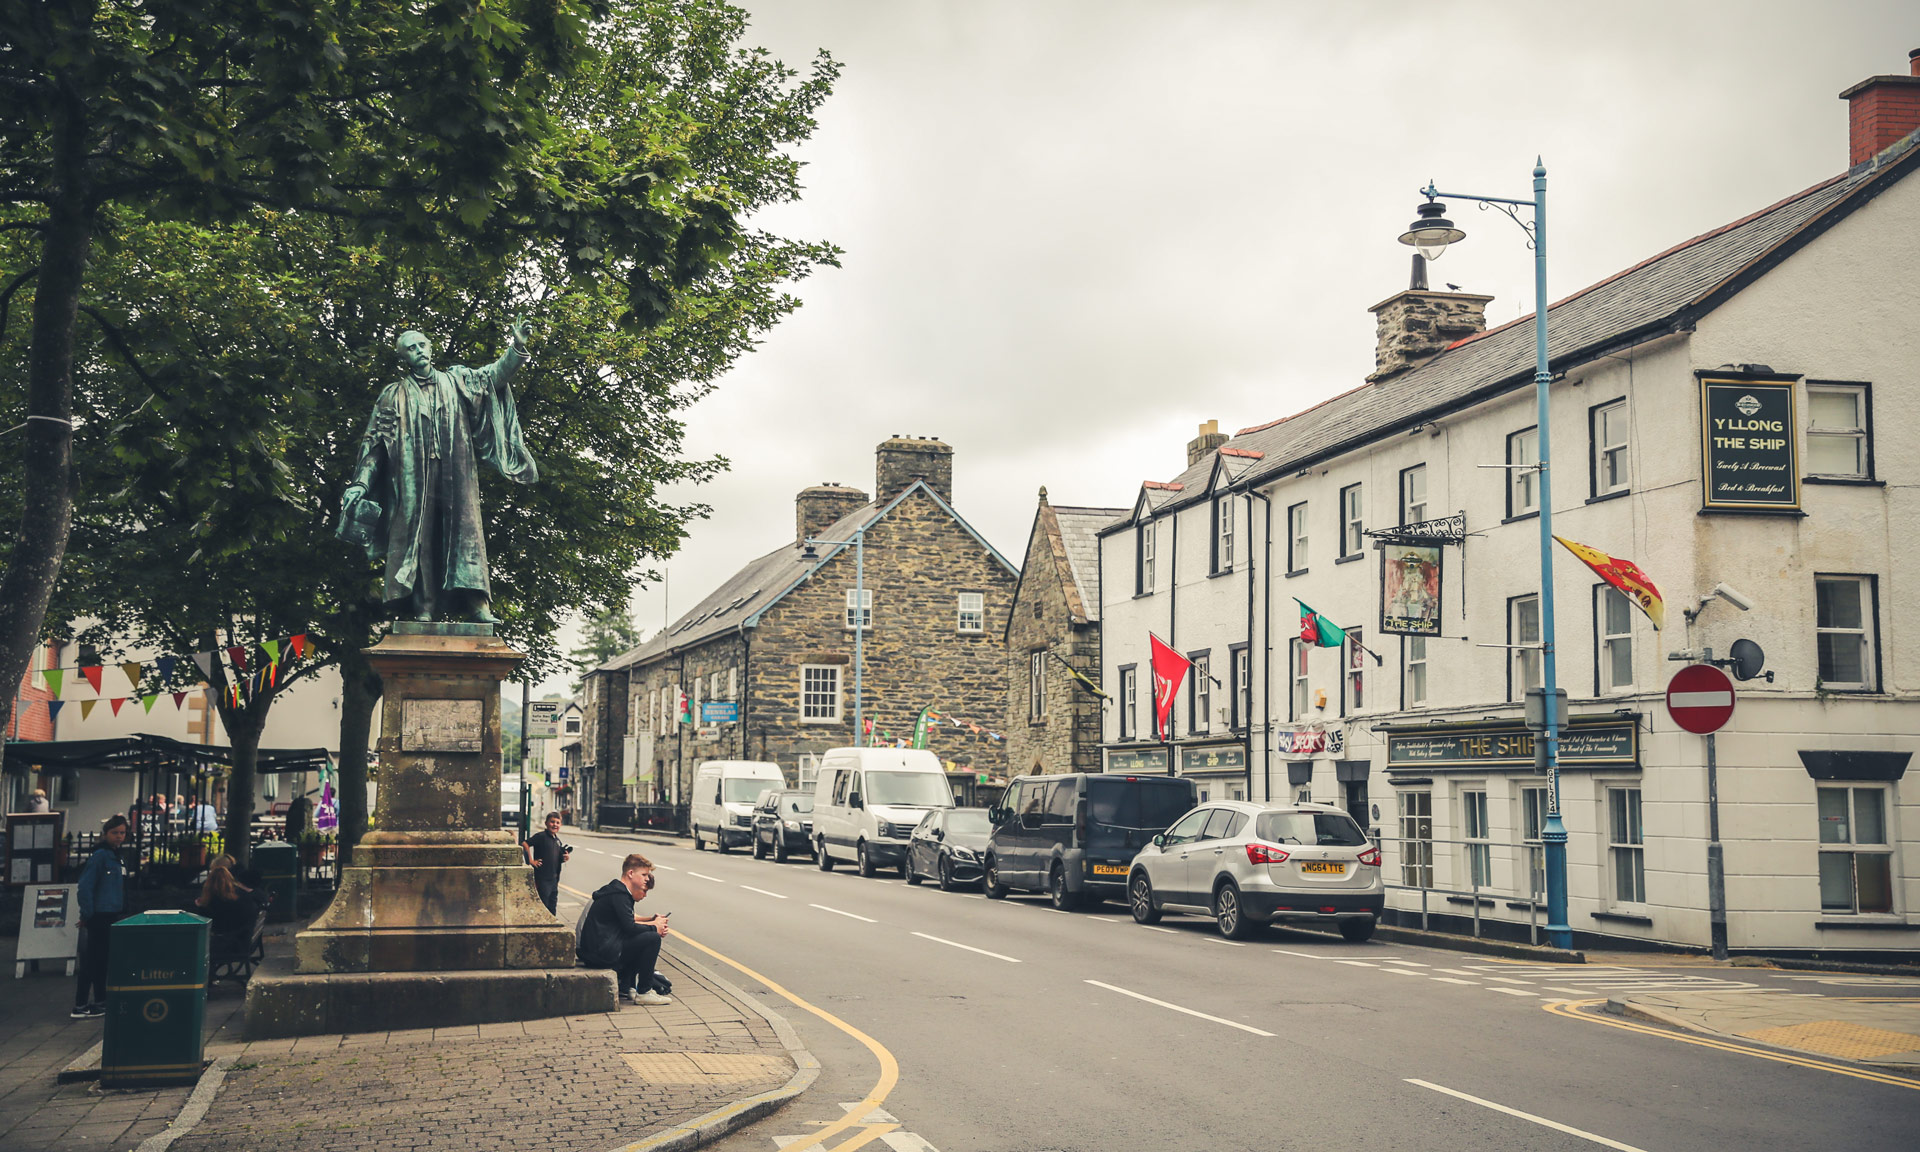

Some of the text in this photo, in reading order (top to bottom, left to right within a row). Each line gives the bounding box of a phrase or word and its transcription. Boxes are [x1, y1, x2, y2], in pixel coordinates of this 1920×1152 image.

[1714, 418, 1783, 432] Y LLONG
[1713, 437, 1786, 450] THE SHIP
[1718, 482, 1739, 491] Bed
[1745, 483, 1785, 495] Breakfast
[1389, 619, 1433, 629] THE SHIP
[1459, 735, 1535, 757] THE SHIP
[1206, 757, 1219, 767] SHIP
[1306, 863, 1344, 873] NG64 TTE
[140, 968, 175, 981] Litter
